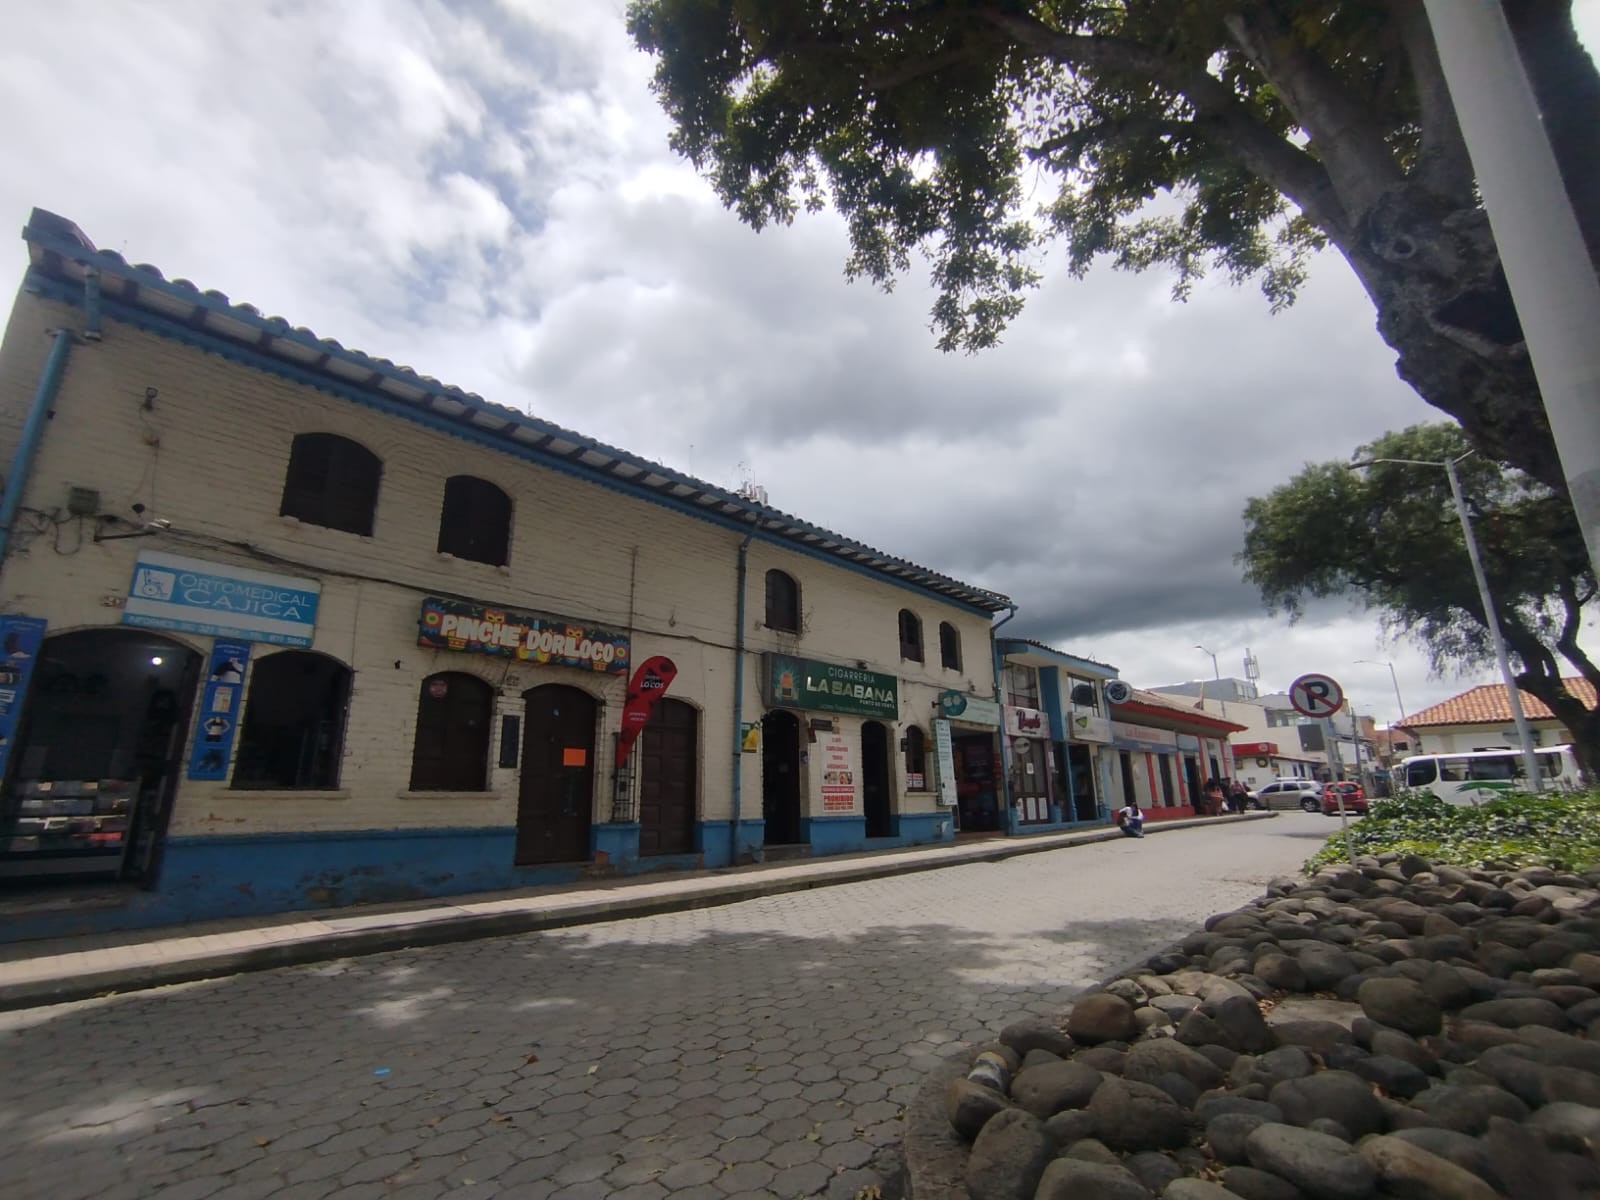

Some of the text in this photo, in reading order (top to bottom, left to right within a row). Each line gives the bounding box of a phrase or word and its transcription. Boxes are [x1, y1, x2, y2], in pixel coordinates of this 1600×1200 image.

[179, 573, 310, 607] ORTOMEDICAL
[183, 588, 301, 619] CAJICA
[440, 614, 614, 662] PINCHE DORILOCO
[806, 675, 894, 703] LA SABANA
[828, 667, 876, 683] CIGARRERIA
[1304, 681, 1329, 710] P
